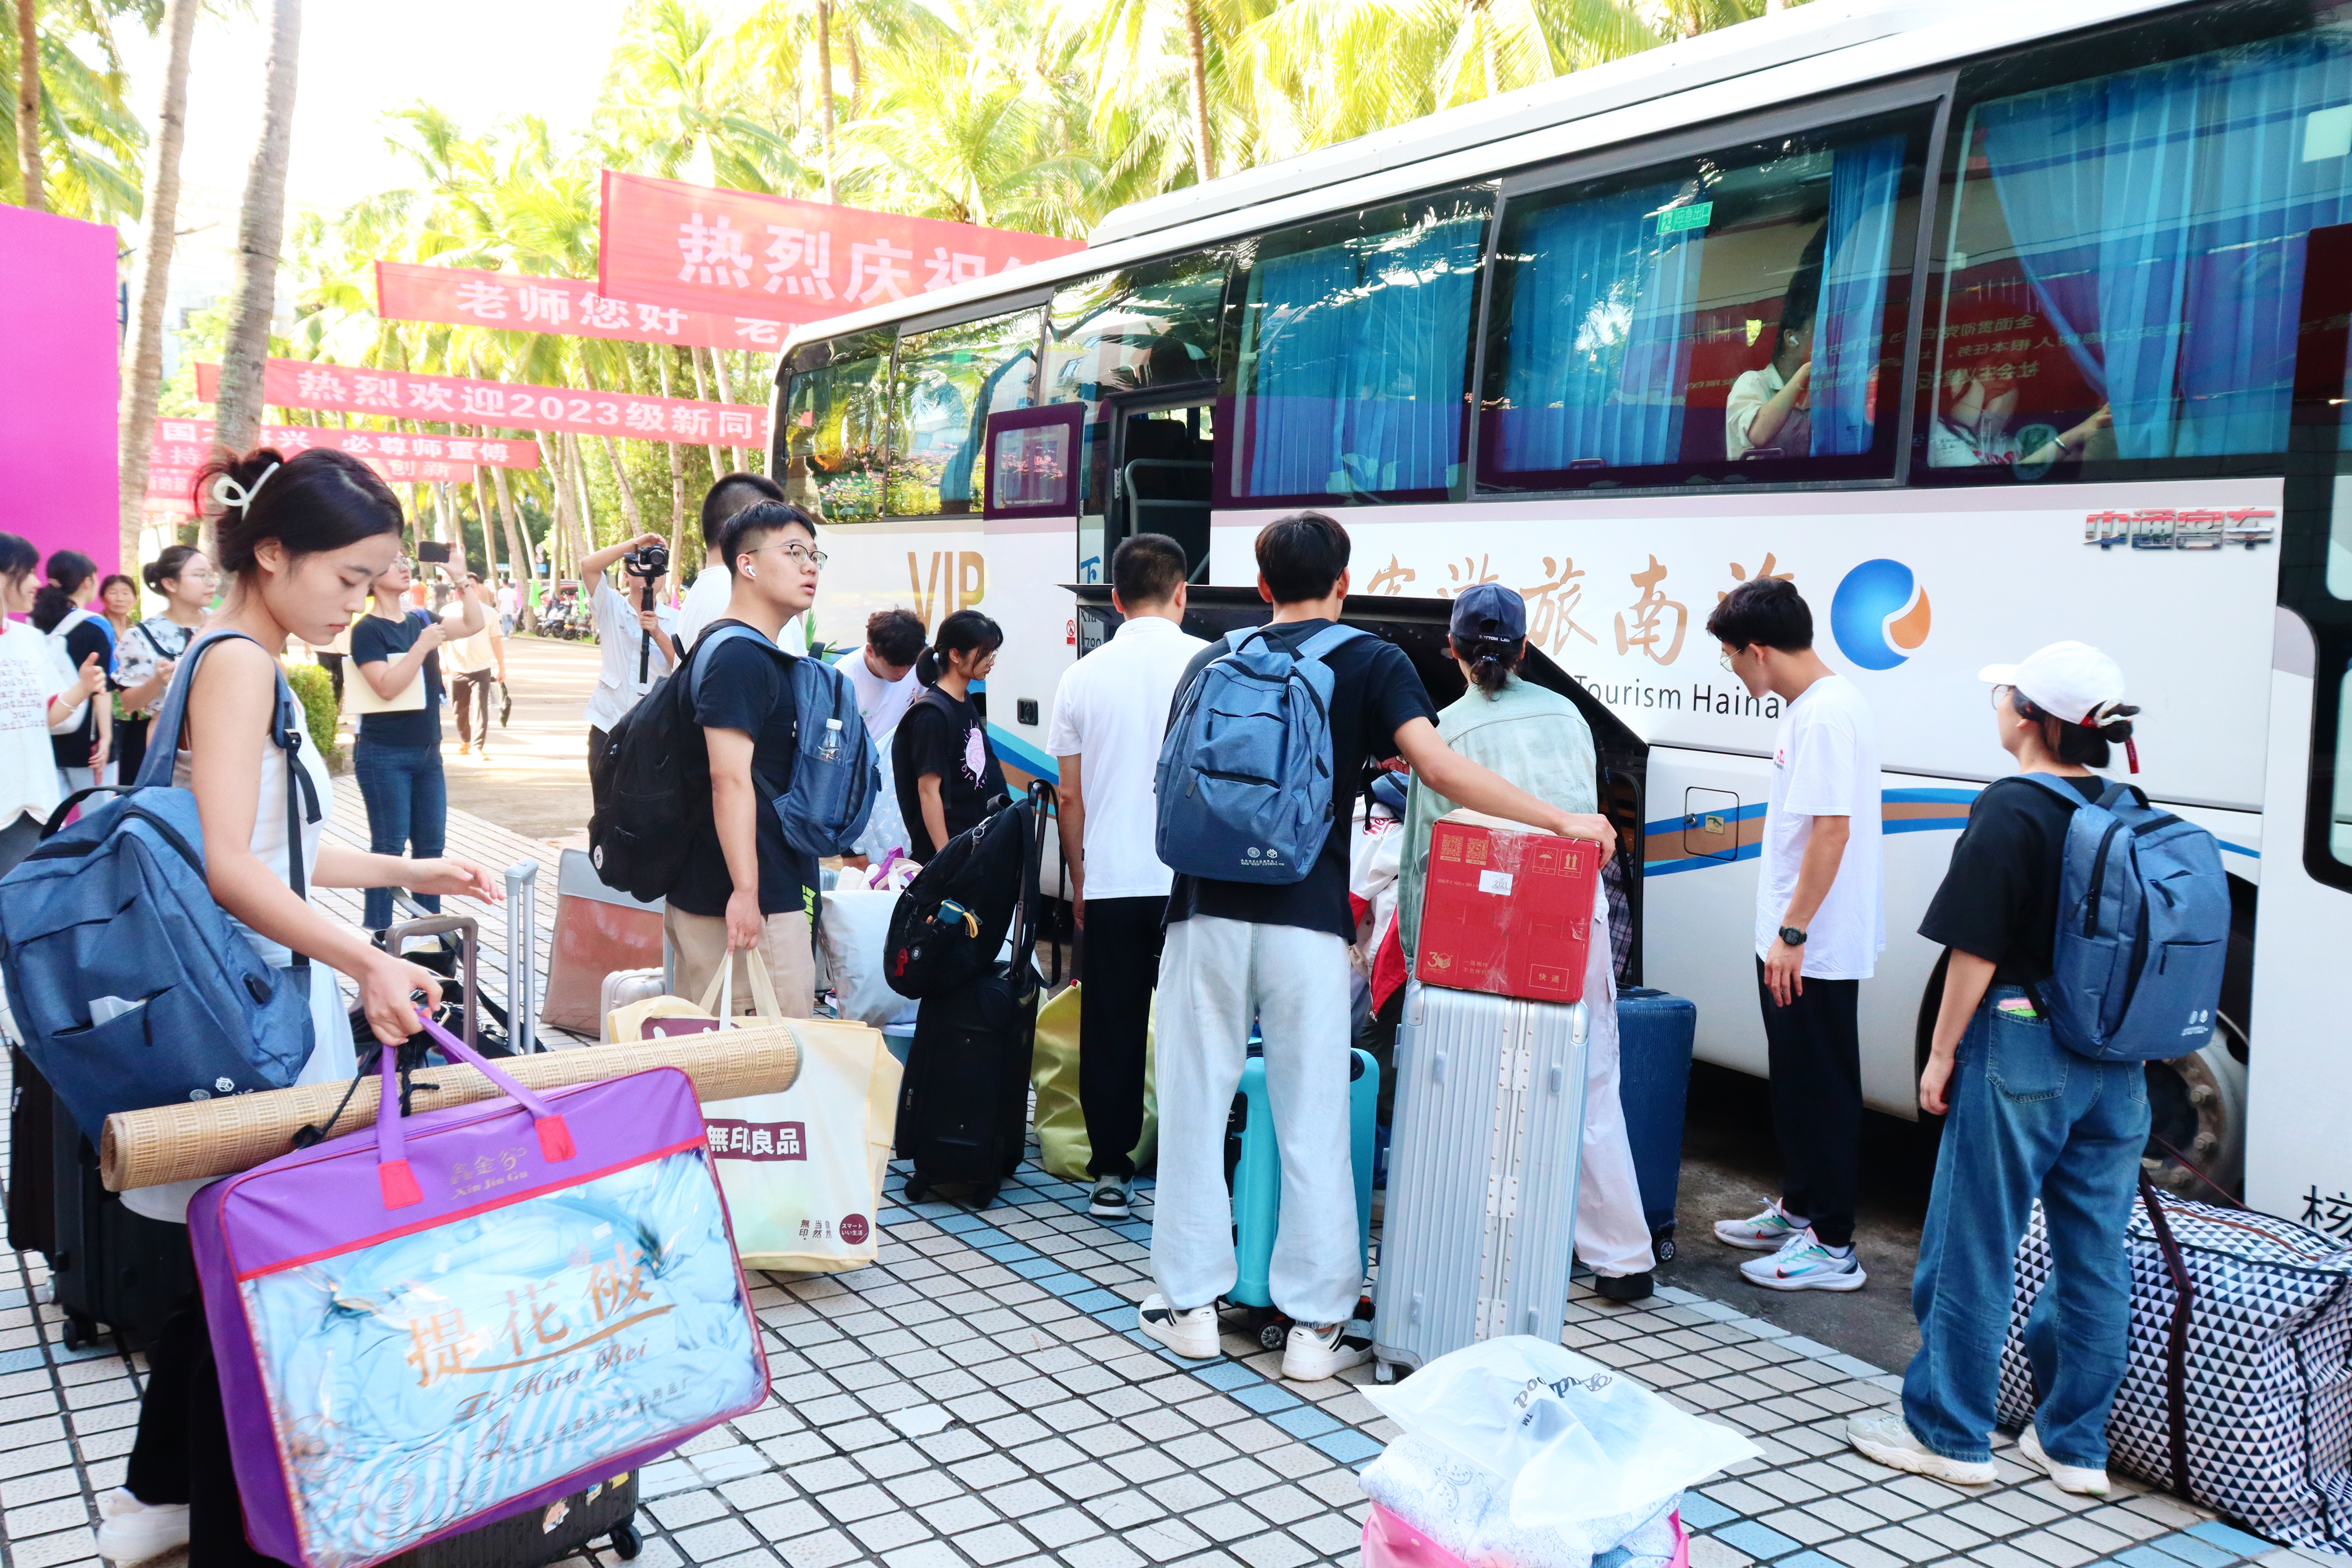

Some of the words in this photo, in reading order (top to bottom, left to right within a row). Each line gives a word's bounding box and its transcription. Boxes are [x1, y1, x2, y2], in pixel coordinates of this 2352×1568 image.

[1676, 204, 1711, 223] 应急出口
[677, 212, 1044, 303] 热烈庆祝
[456, 280, 687, 336] 老师您好
[734, 316, 804, 344] 老
[298, 369, 768, 439] 热烈欢迎2023级新同
[342, 435, 509, 463] 必尊师重傅
[2083, 507, 2275, 550] 中通客车
[907, 551, 984, 635] VIP
[1574, 675, 1681, 710] Tourism
[1693, 684, 1788, 719] Haina
[707, 1124, 800, 1156] 無印良品
